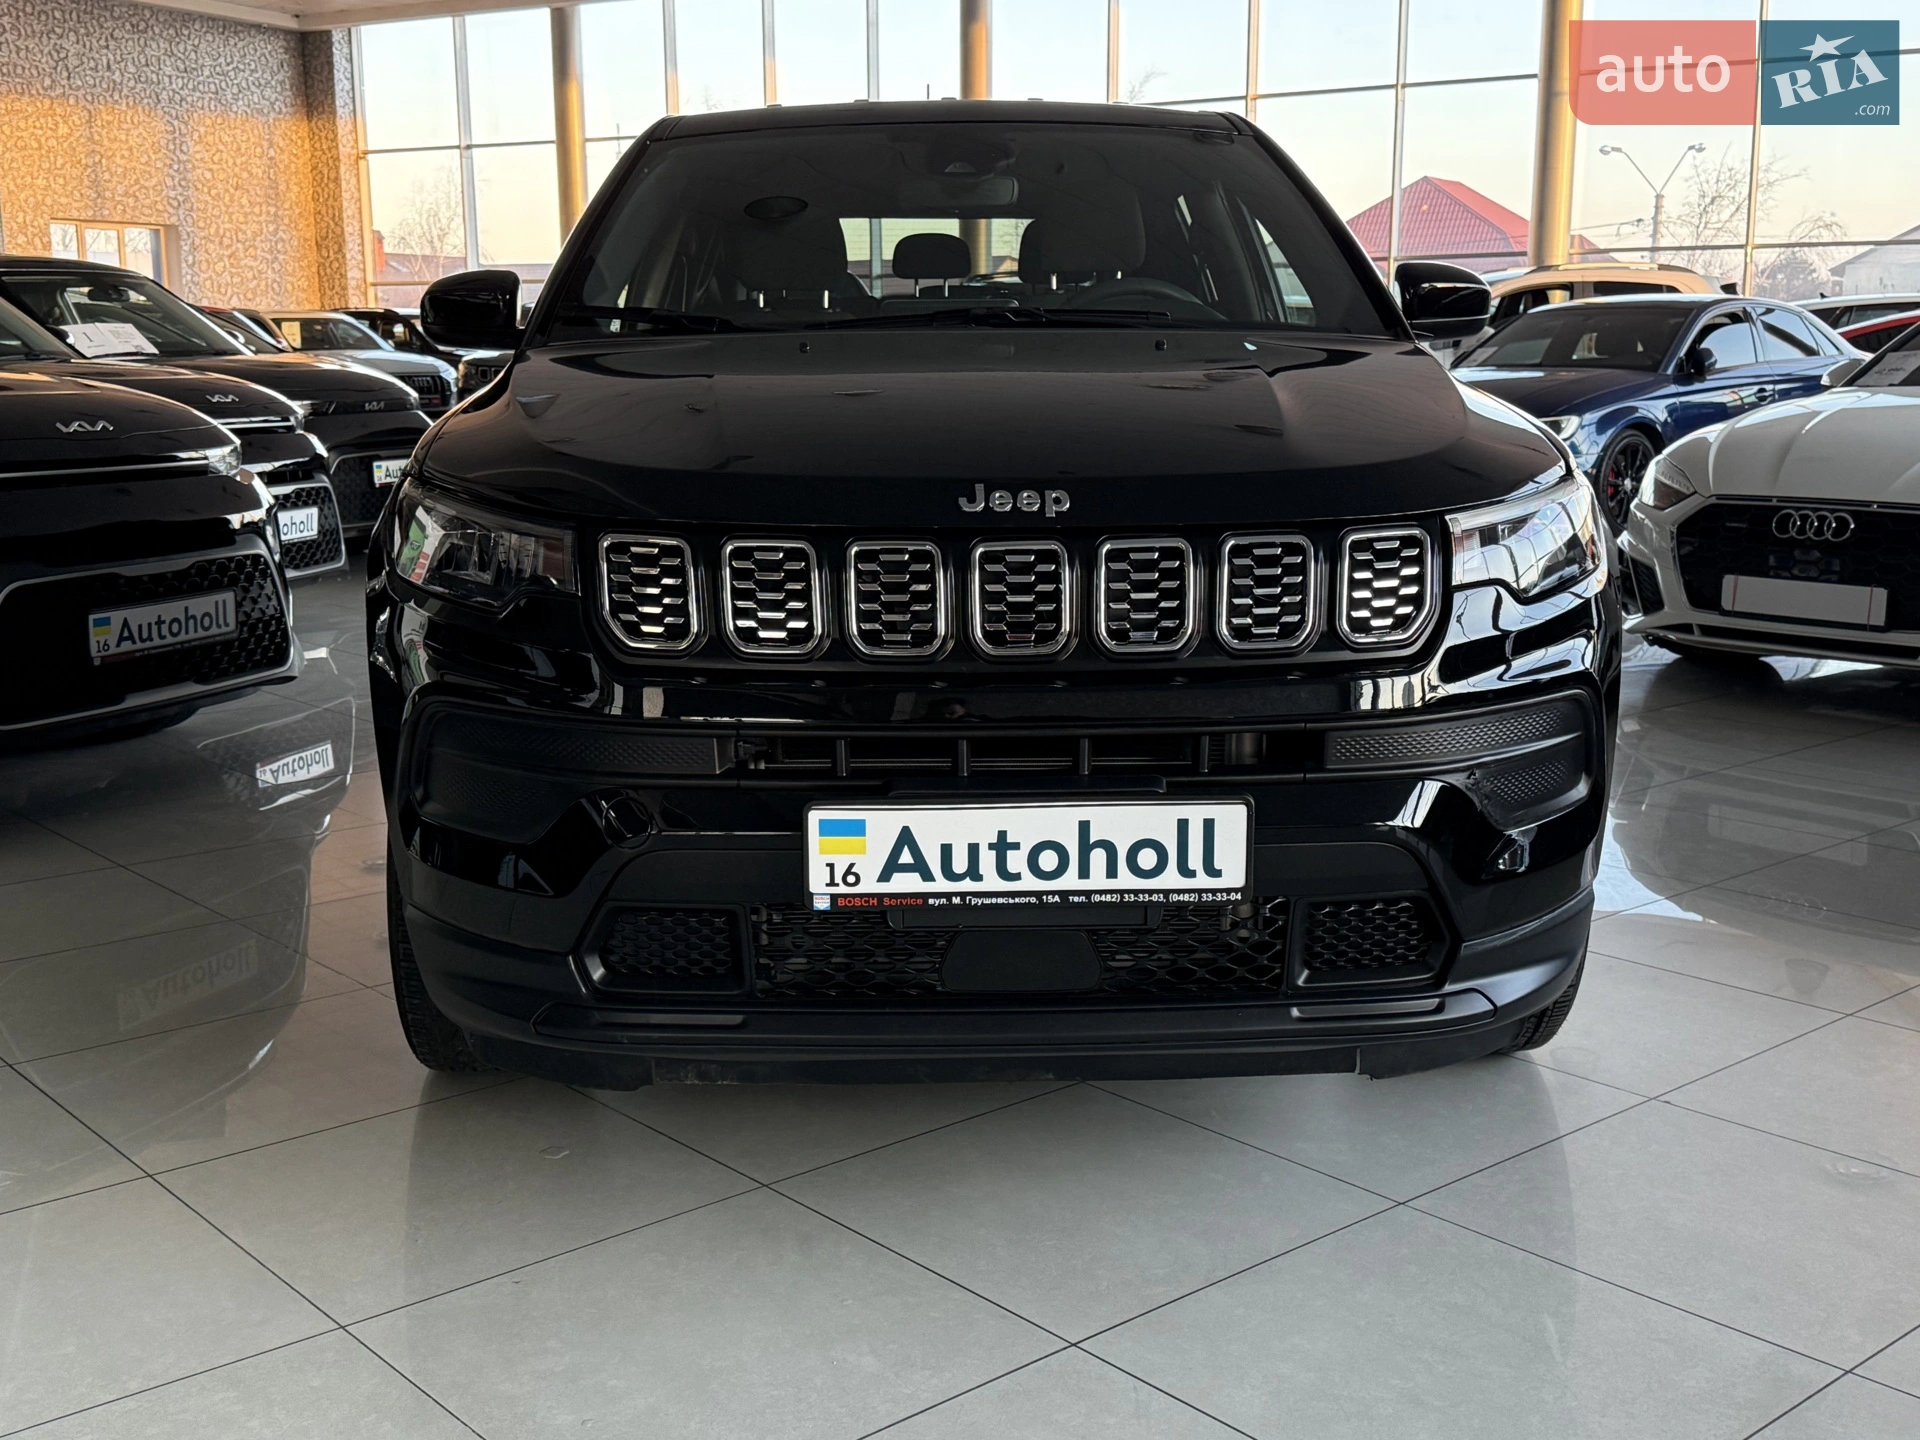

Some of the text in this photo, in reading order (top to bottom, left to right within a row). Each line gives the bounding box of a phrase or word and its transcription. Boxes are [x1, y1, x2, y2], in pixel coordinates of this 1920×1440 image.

[958, 483, 1070, 517] Jeep
[115, 599, 230, 648] Autoholl
[96, 639, 110, 653] 16
[825, 818, 1222, 887] 16 Autoholl
[837, 897, 923, 906] BOSCH Service
[928, 897, 949, 905] вул.
[952, 896, 963, 904] М.
[966, 896, 1039, 905] Грушевського,
[1042, 895, 1060, 903] 15А
[1091, 894, 1120, 903] (0482)
[1123, 894, 1166, 902] 33-33-03,
[1169, 893, 1198, 902] (0482)
[1201, 893, 1241, 901] 33-33-04
